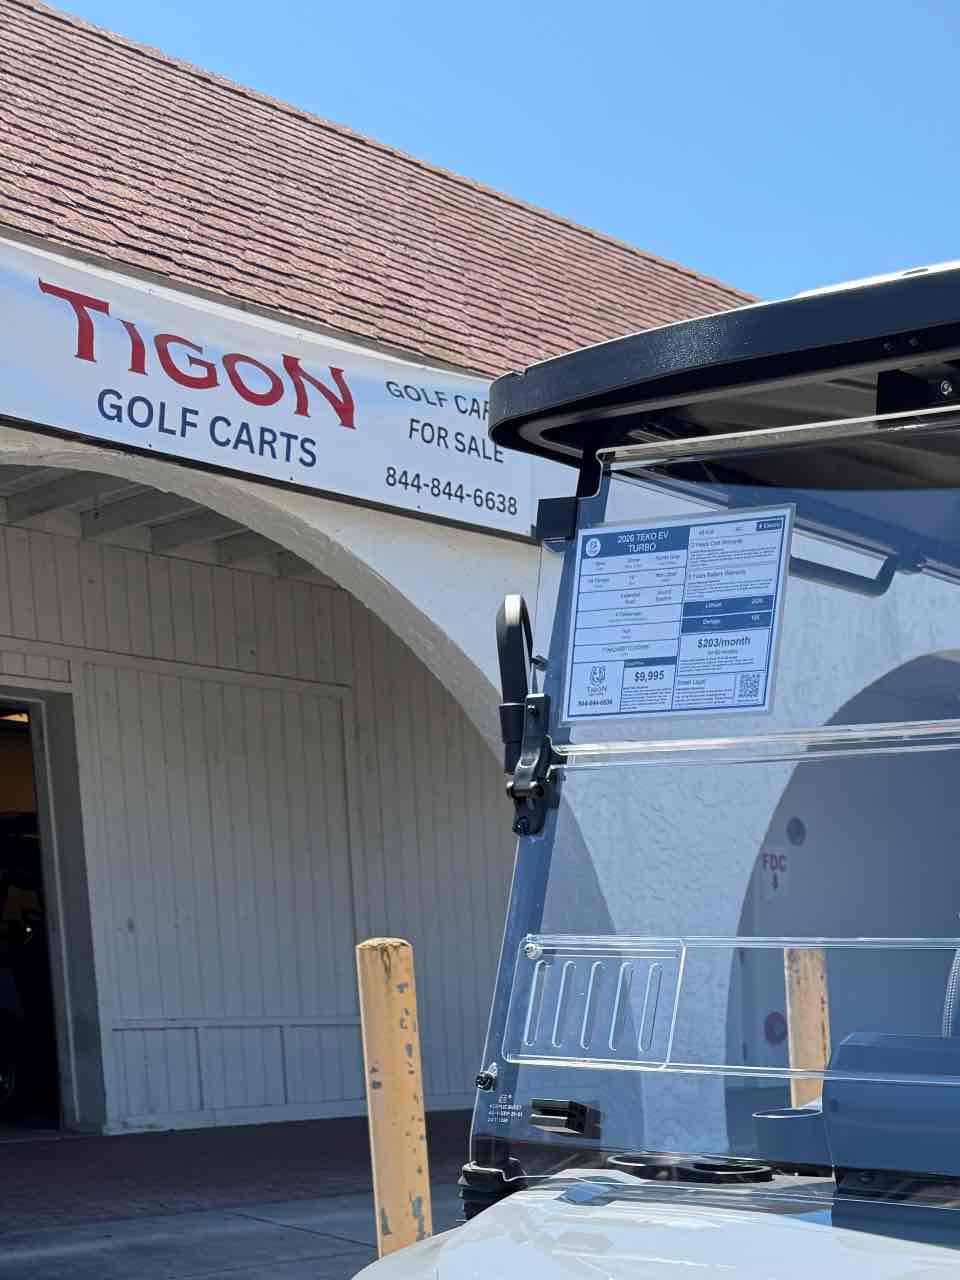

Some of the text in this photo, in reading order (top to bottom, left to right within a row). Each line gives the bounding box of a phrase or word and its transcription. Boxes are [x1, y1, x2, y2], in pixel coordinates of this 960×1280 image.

[38, 278, 357, 430] TIGON
[385, 380, 449, 408] GOLF
[97, 388, 318, 469] GOLF CARTS
[408, 417, 505, 464] FOR SALE
[385, 466, 518, 516] 844-844-6638
[697, 637, 751, 649] $203/month
[634, 670, 665, 683] $9,995
[761, 853, 787, 873] FDC
